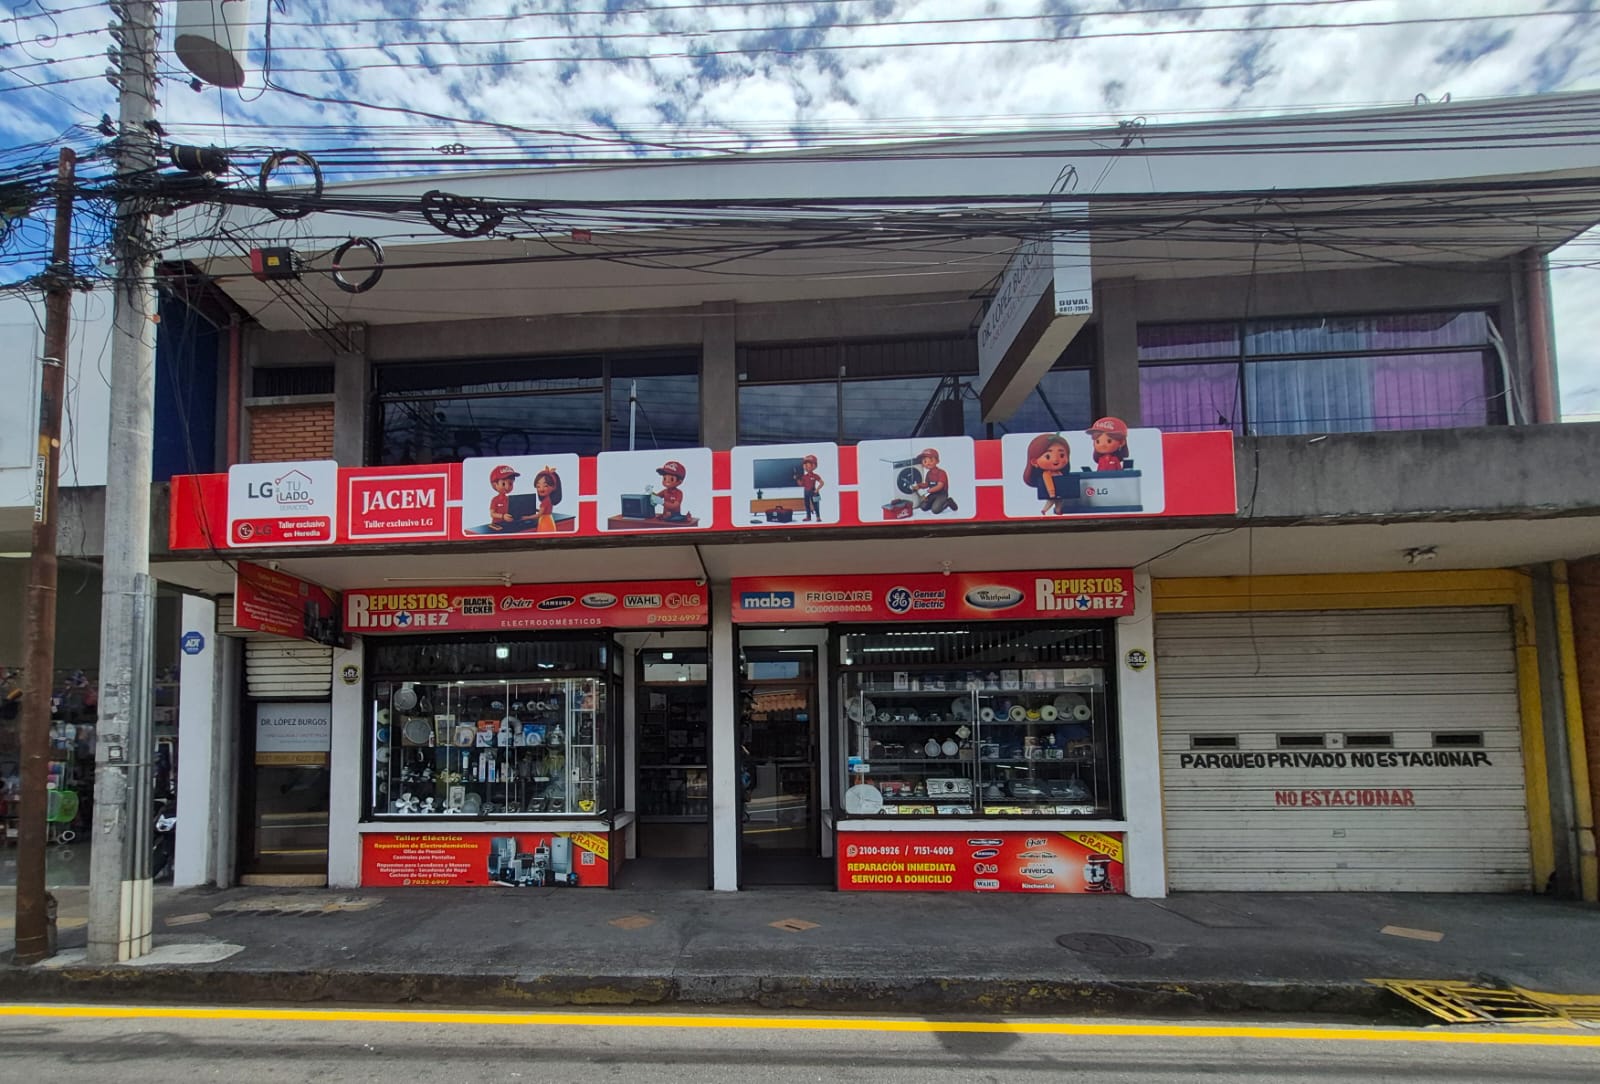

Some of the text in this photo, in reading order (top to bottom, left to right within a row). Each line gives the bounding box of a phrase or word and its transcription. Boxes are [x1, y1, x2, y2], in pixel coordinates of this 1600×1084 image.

[1058, 298, 1089, 306] DUVAL
[248, 482, 273, 499] LG
[286, 480, 302, 492] TU
[280, 491, 309, 501] LADO
[361, 489, 436, 515] JACEM
[278, 520, 325, 529] Taller exclusivo
[364, 518, 433, 529] Taller exclusivo LG
[255, 524, 272, 535] LG
[294, 529, 321, 538] Heredia
[806, 591, 873, 601] FRIGIDAIRE
[913, 590, 945, 599] General
[978, 592, 1011, 601] Whirlpool
[1035, 578, 1123, 611] REPUESTOS
[501, 596, 534, 609] Oster
[542, 599, 571, 607] SAMSUNG
[627, 596, 658, 605] WAHL
[682, 594, 700, 606] LG
[744, 592, 791, 608] mabe
[913, 600, 945, 608] Electric
[348, 593, 449, 627] REPUESTOS
[463, 606, 494, 614] DECKER
[656, 614, 701, 622] 7032-6997
[297, 718, 327, 726] BURGOS
[1180, 751, 1492, 769] PARQUEO PRIVADO NO ESTACIONAR
[1275, 788, 1416, 807] NO ESTACIONAR
[1026, 838, 1047, 848] Oster
[1079, 833, 1119, 857] GRATIS
[859, 846, 900, 855] 2100-8926
[913, 846, 954, 855] 7151-4009
[847, 860, 957, 872] REPARACIÓN INMEDIATA
[851, 874, 953, 884] SERVICIO A DOMICILIO
